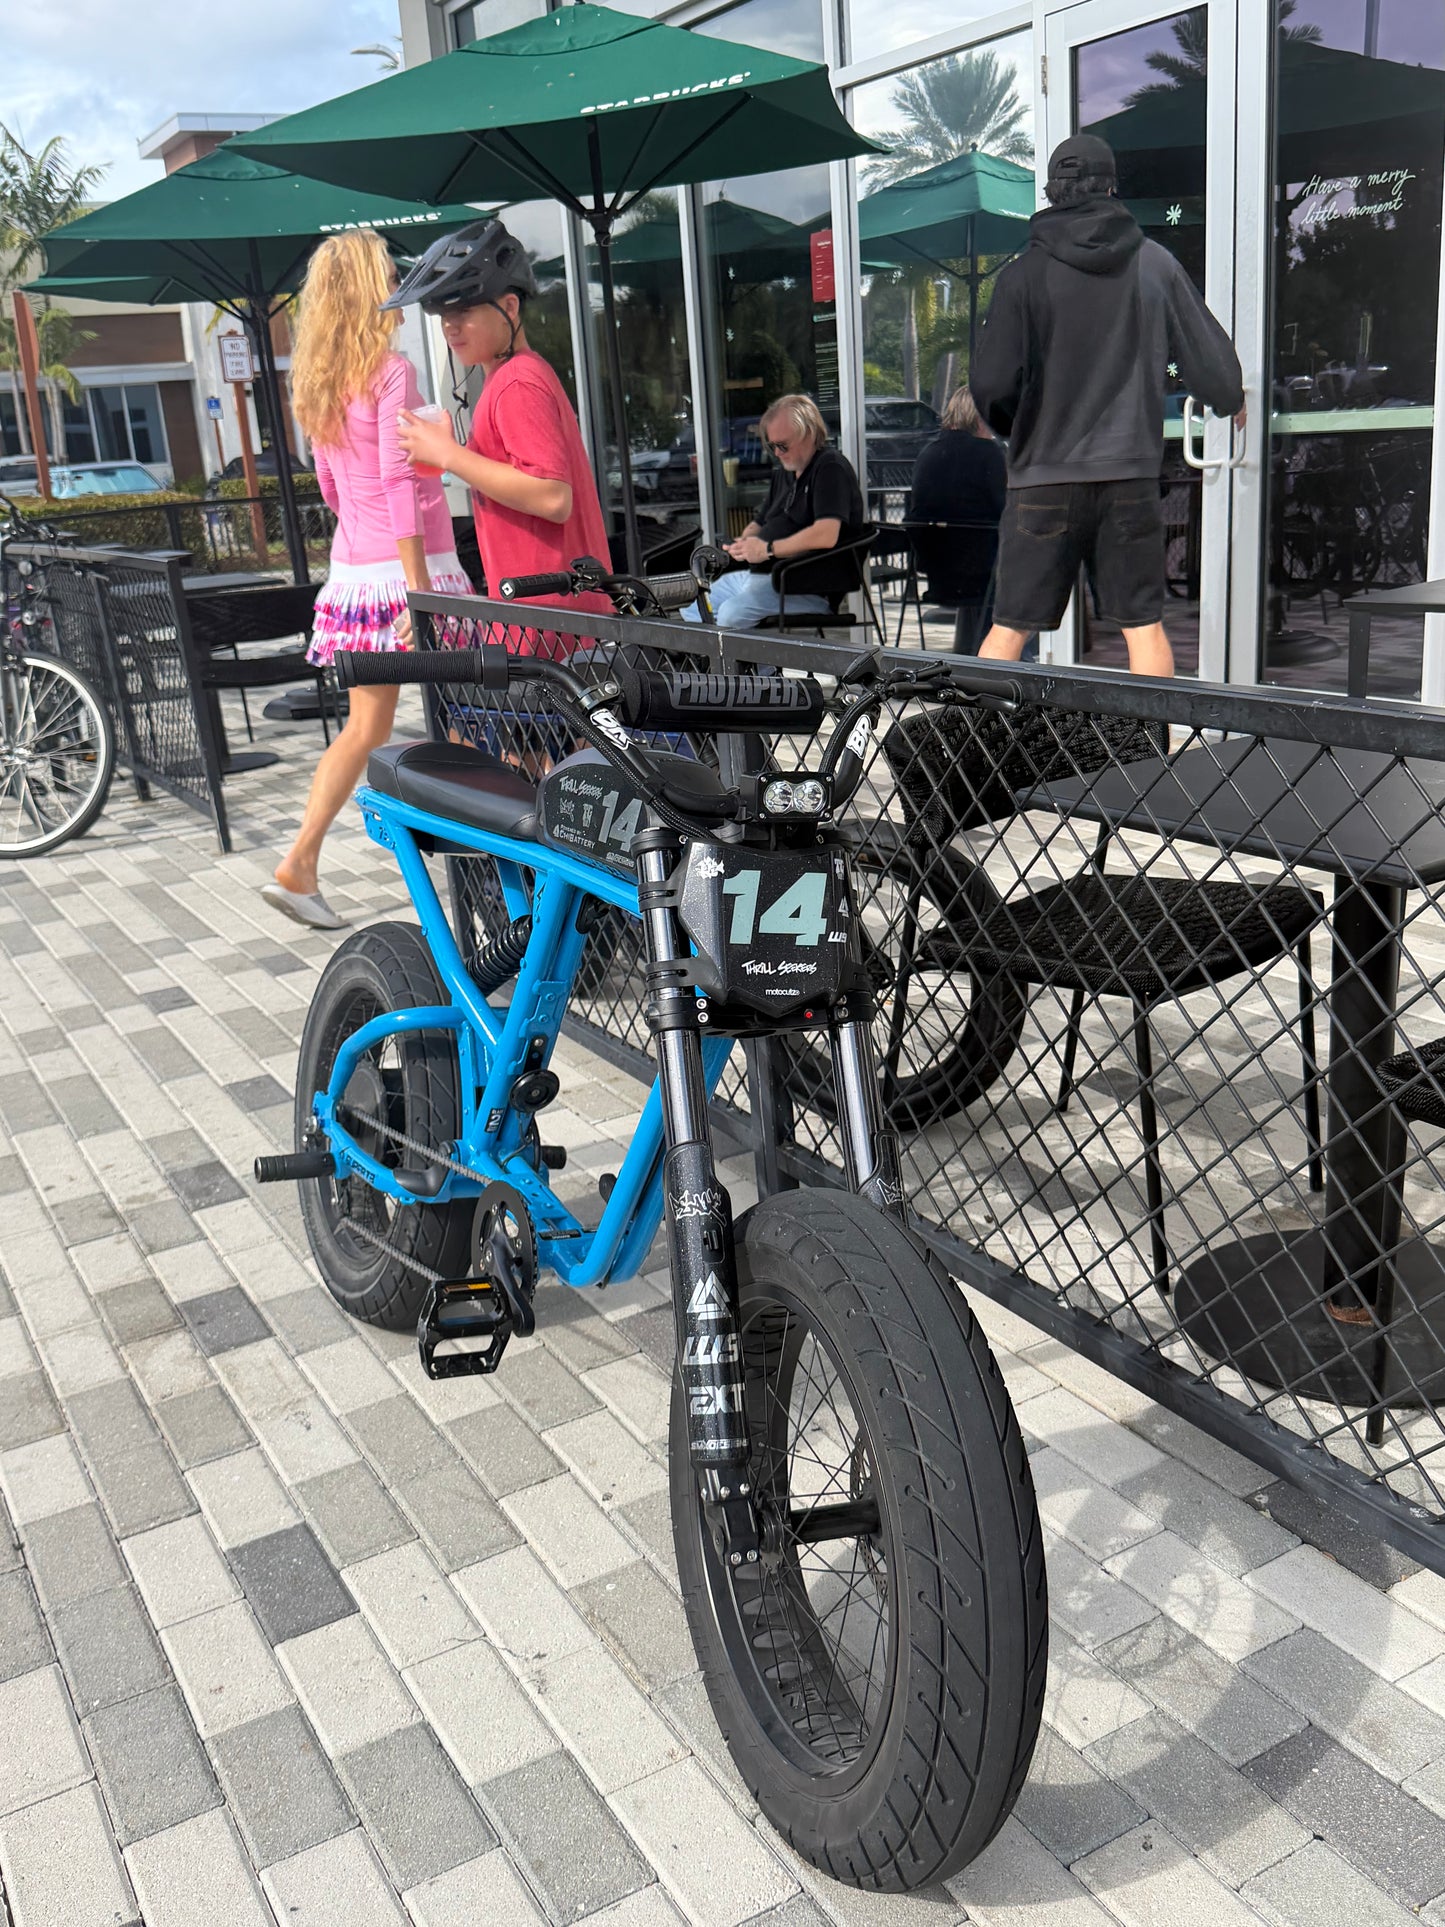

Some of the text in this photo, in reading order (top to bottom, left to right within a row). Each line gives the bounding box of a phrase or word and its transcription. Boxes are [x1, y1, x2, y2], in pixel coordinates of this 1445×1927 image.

[1302, 168, 1416, 196] Have a merry
[1300, 192, 1403, 225] little moment
[598, 790, 643, 852] 14
[722, 869, 828, 946] 14
[741, 960, 818, 976] THRILL SEEKERS
